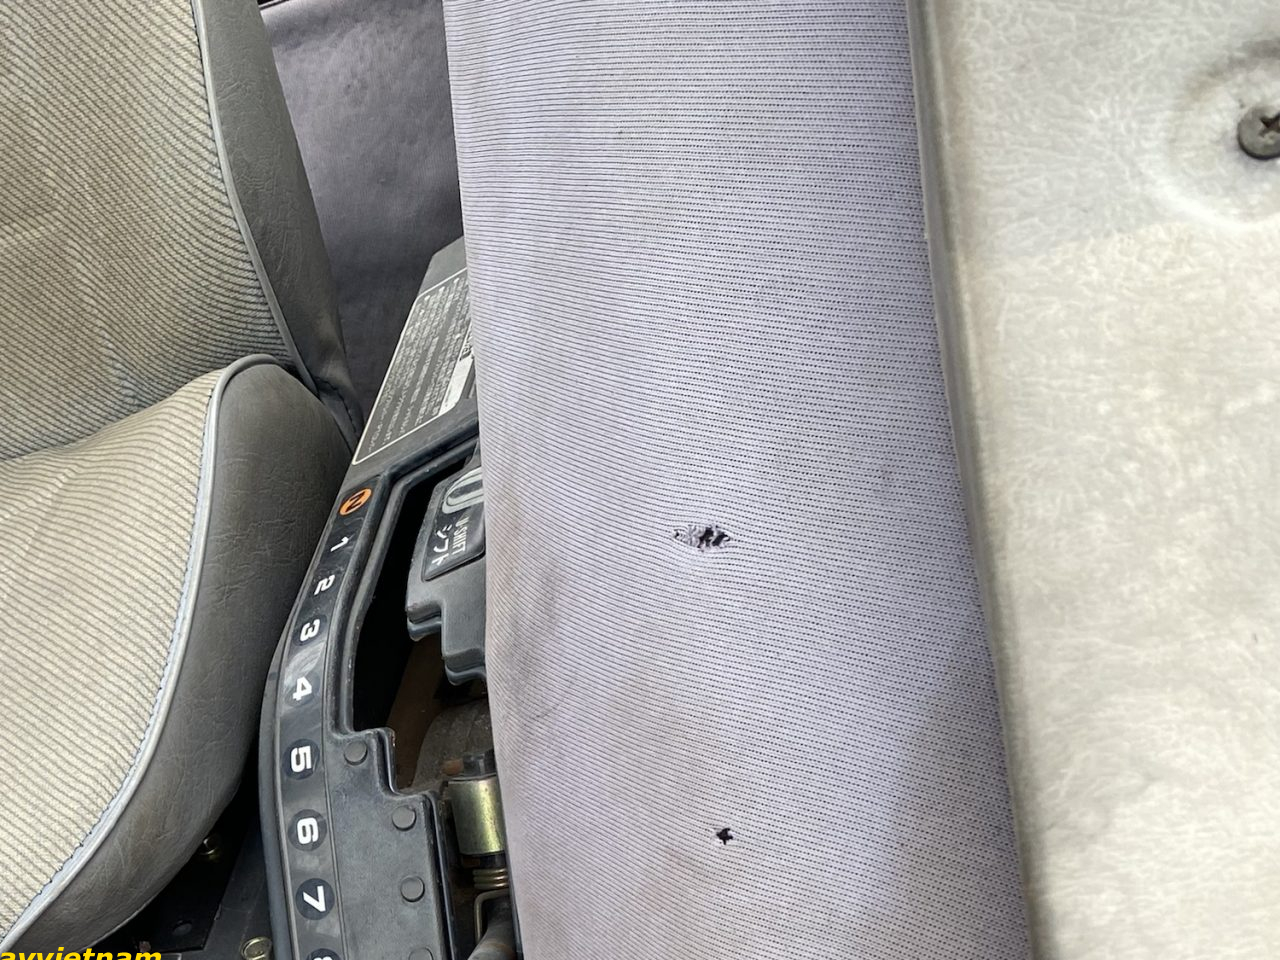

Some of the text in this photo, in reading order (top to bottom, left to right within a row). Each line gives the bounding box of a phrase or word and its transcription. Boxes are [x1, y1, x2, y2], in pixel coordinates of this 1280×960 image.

[330, 536, 350, 552] 1
[431, 524, 452, 566] シフト
[314, 574, 335, 596] 2
[300, 619, 320, 642] 3
[292, 676, 312, 702] 4
[290, 745, 312, 773] 5
[297, 817, 319, 845] 6
[303, 885, 326, 914] 7
